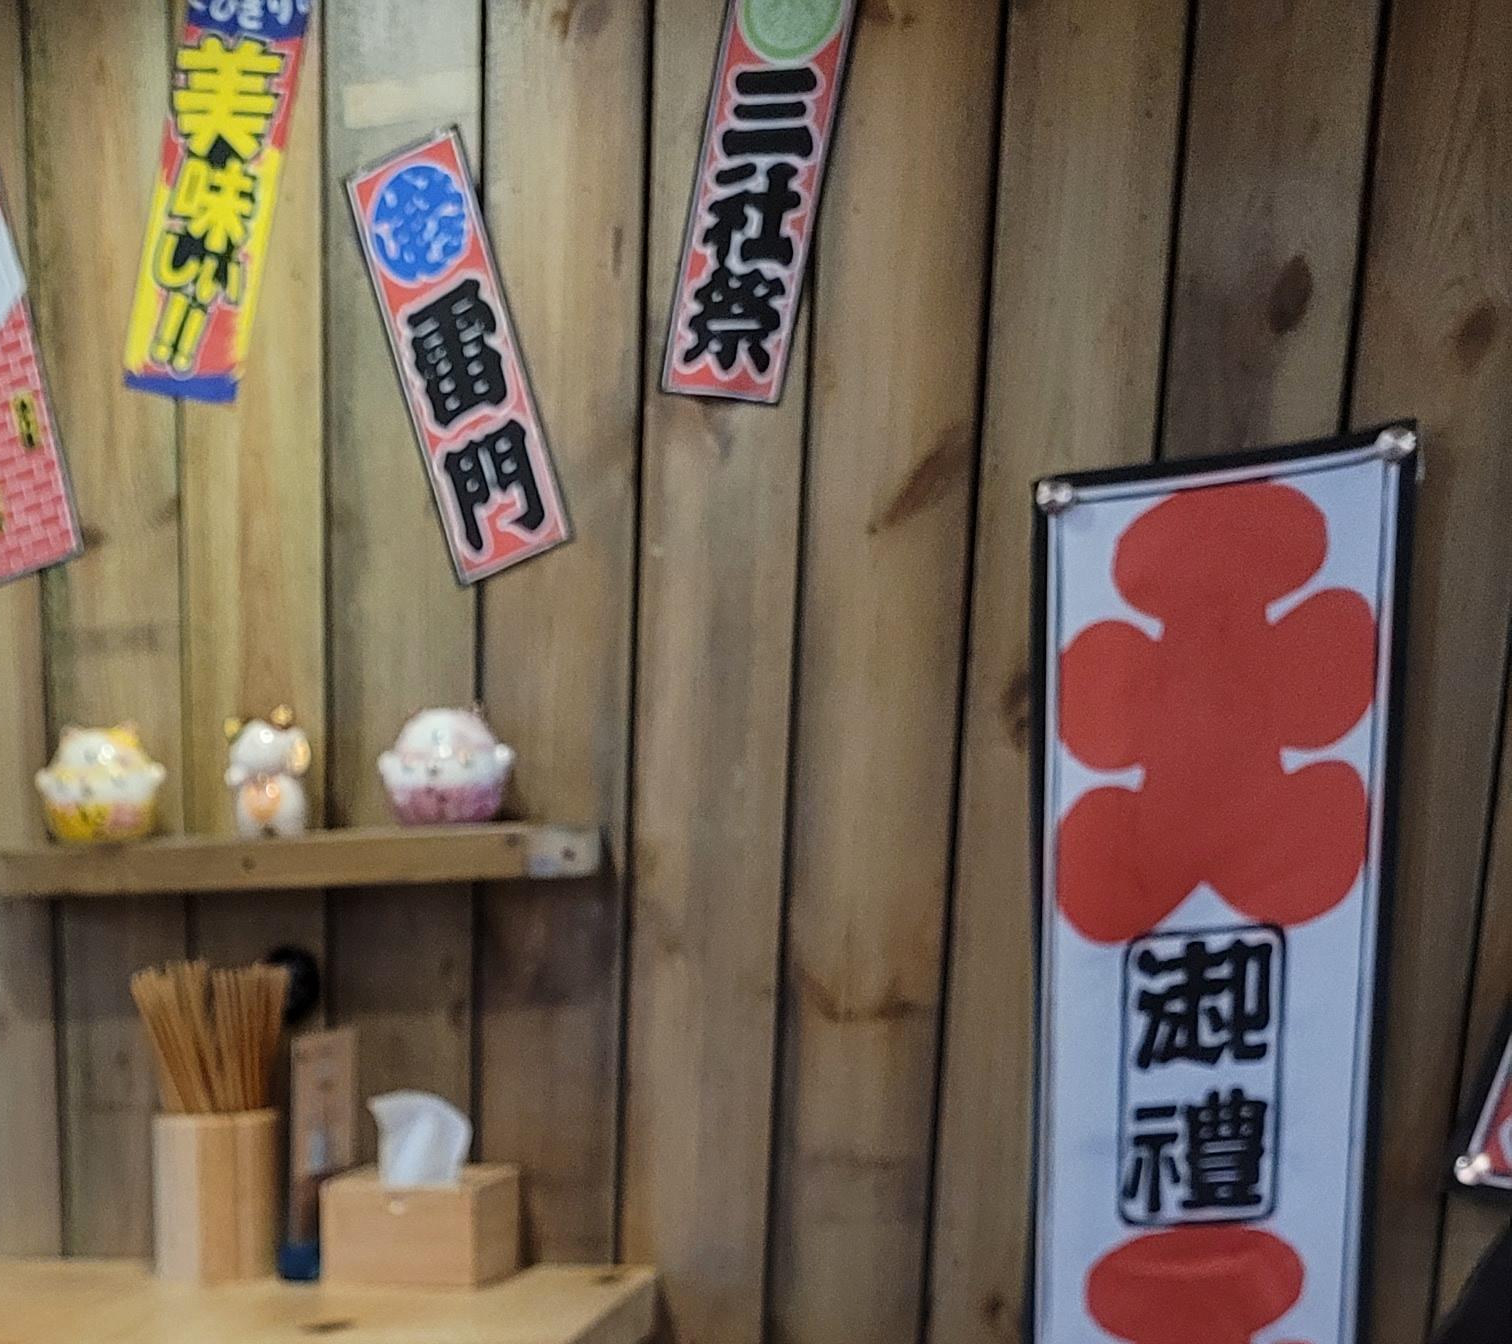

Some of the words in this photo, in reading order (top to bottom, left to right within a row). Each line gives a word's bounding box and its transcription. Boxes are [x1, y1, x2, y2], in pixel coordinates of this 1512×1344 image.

[682, 67, 818, 375] 三社祭
[407, 278, 546, 552] 雷門
